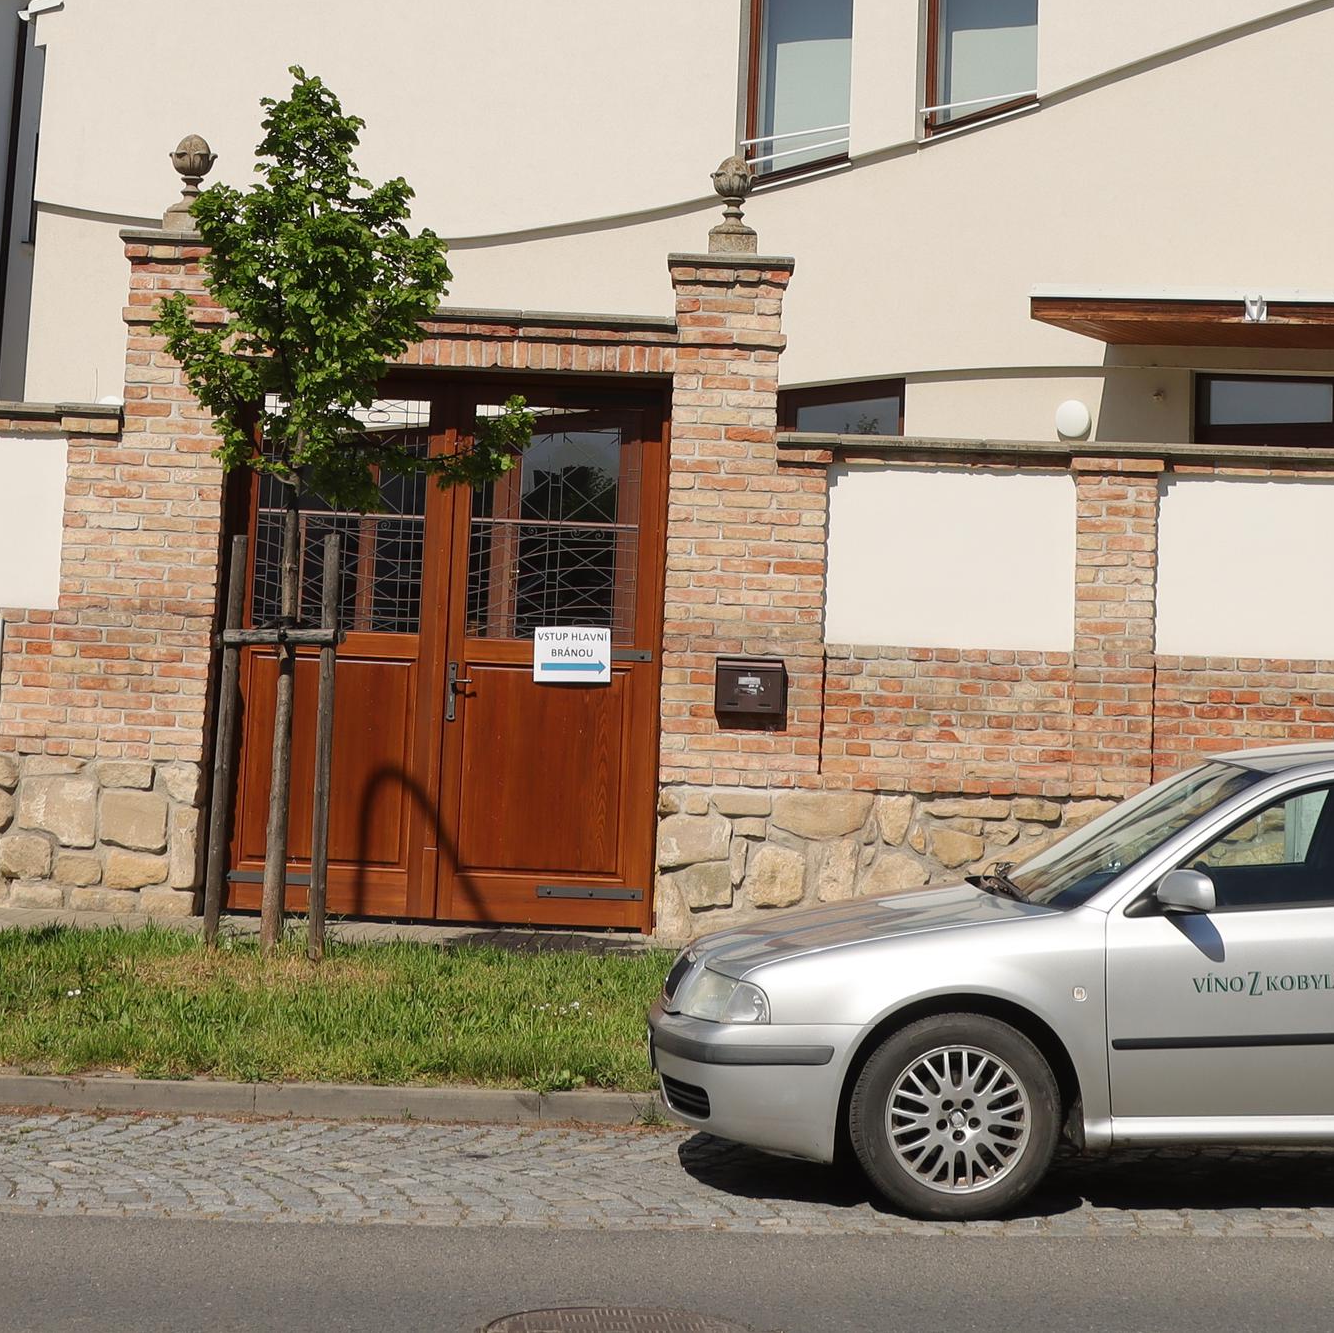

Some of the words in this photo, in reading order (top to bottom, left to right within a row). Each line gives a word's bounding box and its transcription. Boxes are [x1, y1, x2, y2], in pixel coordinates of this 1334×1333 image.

[538, 632, 568, 641] VSTUP
[571, 632, 607, 642] HLAVNÍ
[551, 647, 594, 657] BRÁNOU
[1192, 973, 1244, 994] VÍNO
[1247, 971, 1263, 996] Z
